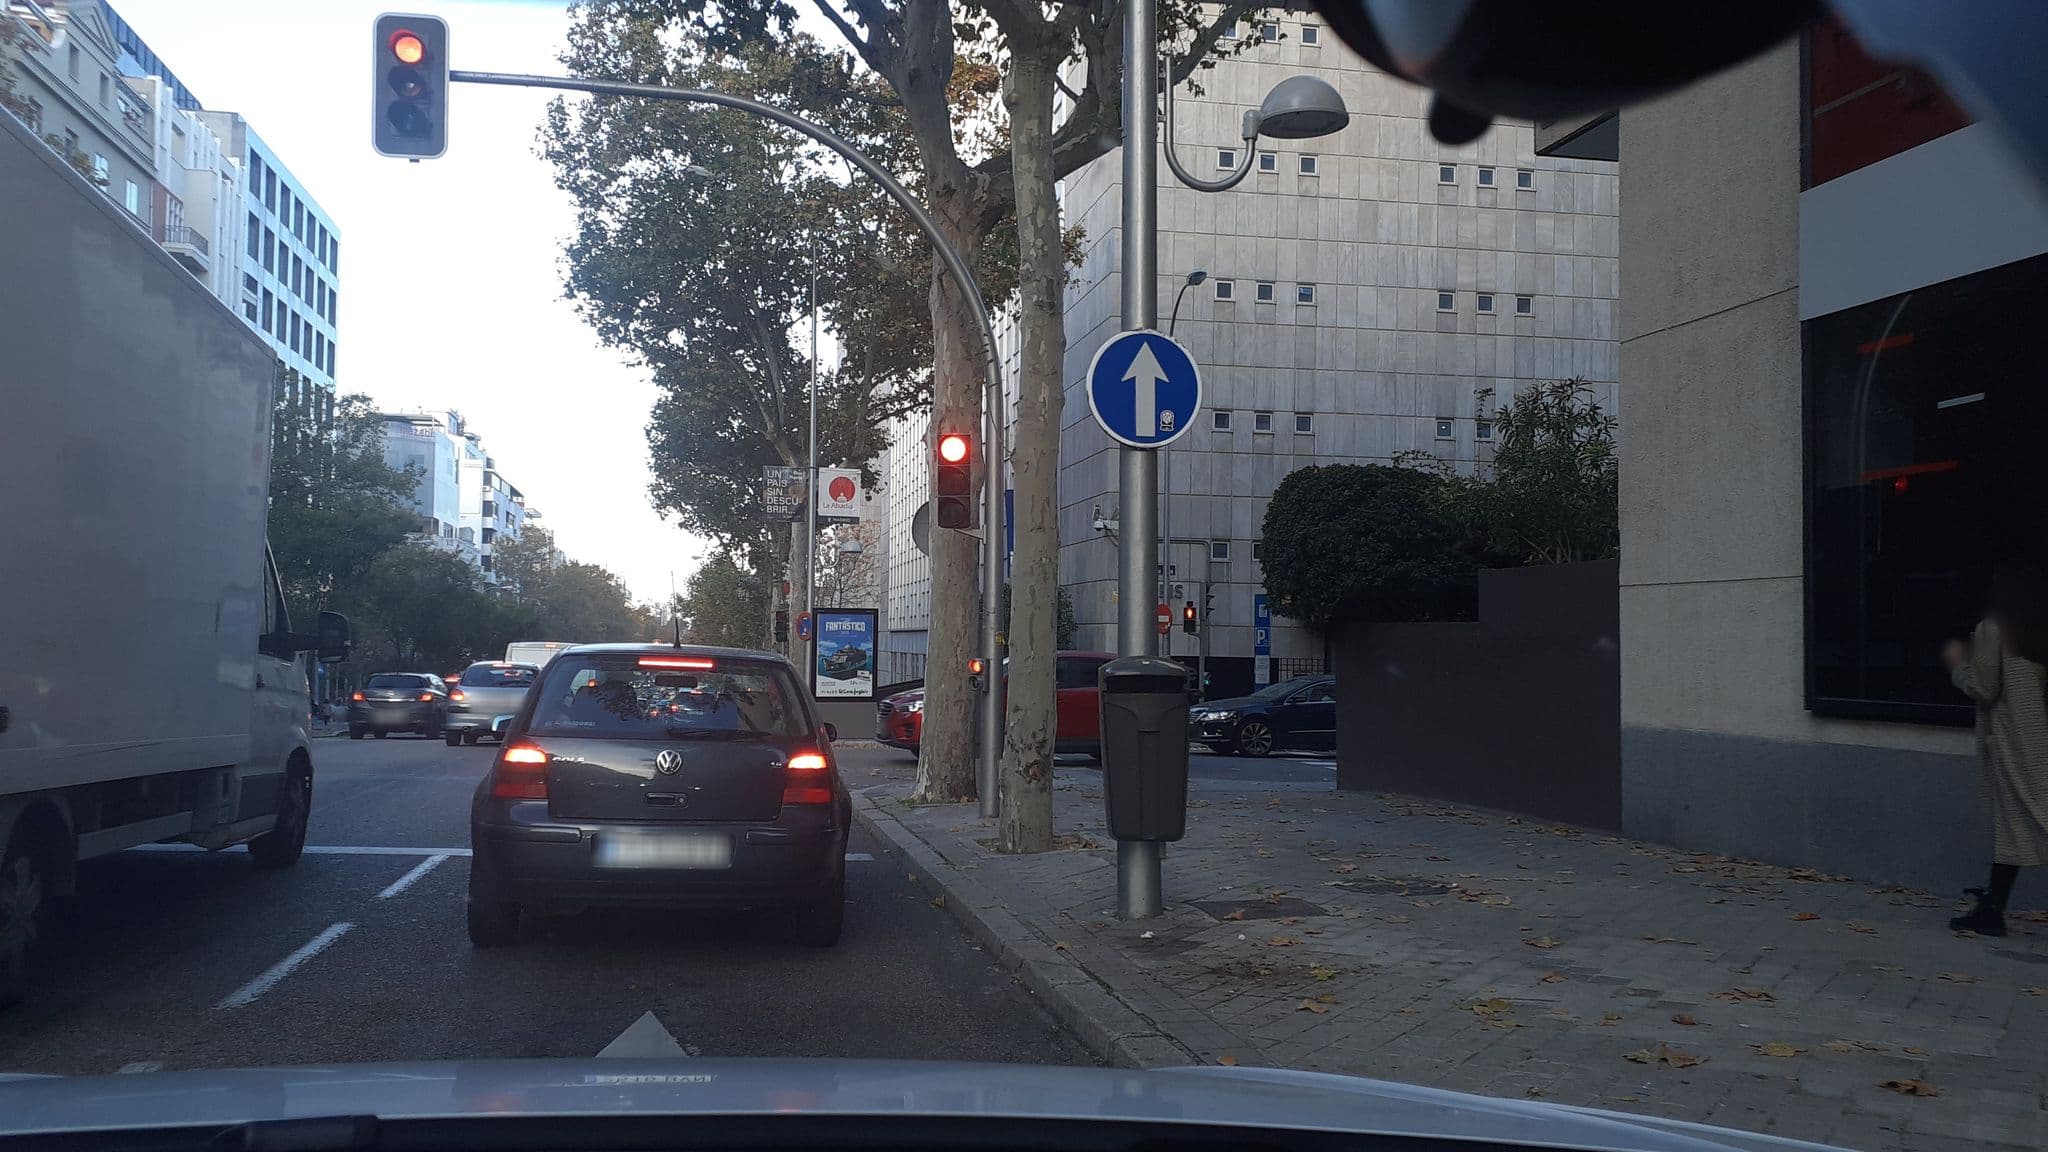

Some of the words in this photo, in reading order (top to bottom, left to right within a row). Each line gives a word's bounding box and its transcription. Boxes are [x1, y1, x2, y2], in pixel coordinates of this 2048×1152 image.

[767, 470, 782, 478] UN
[767, 488, 783, 496] SIN
[767, 496, 802, 505] DESCU-
[1257, 629, 1266, 644] P
